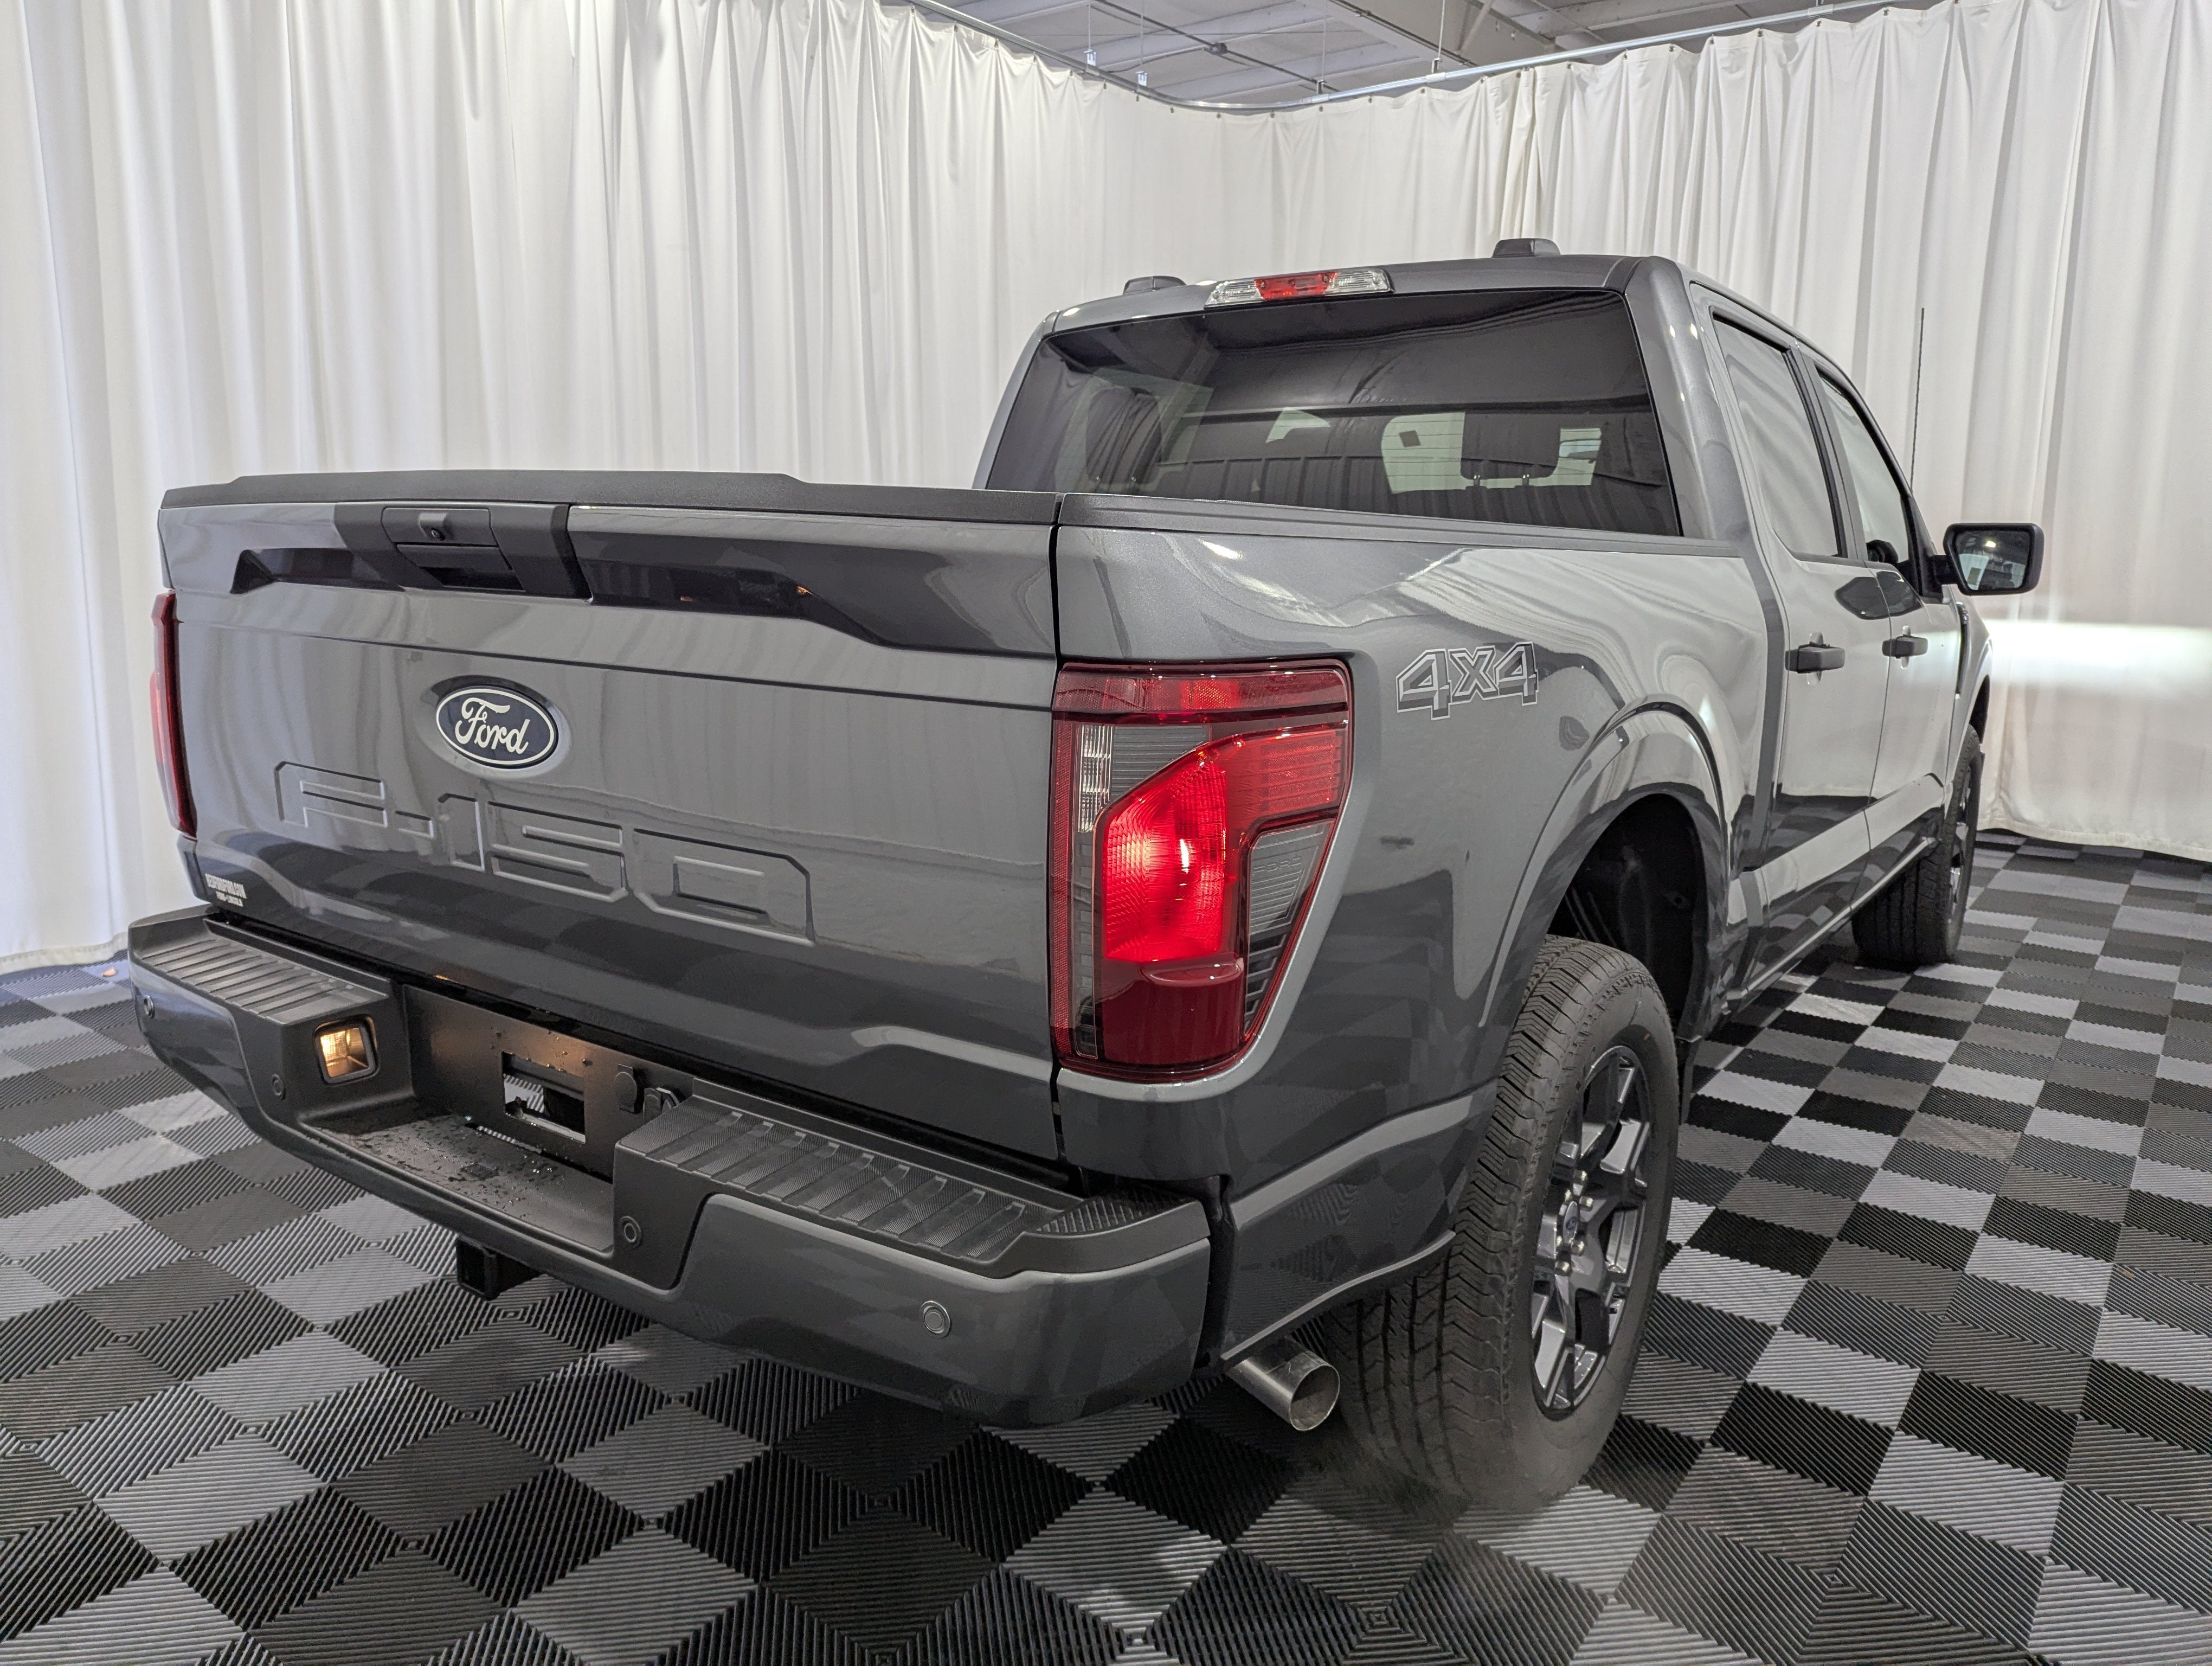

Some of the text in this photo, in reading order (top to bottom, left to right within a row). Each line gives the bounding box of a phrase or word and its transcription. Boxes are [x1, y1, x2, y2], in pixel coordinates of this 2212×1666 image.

[1396, 642, 1539, 721] 4X4
[455, 697, 530, 754] Ford
[274, 761, 815, 947] F-150
